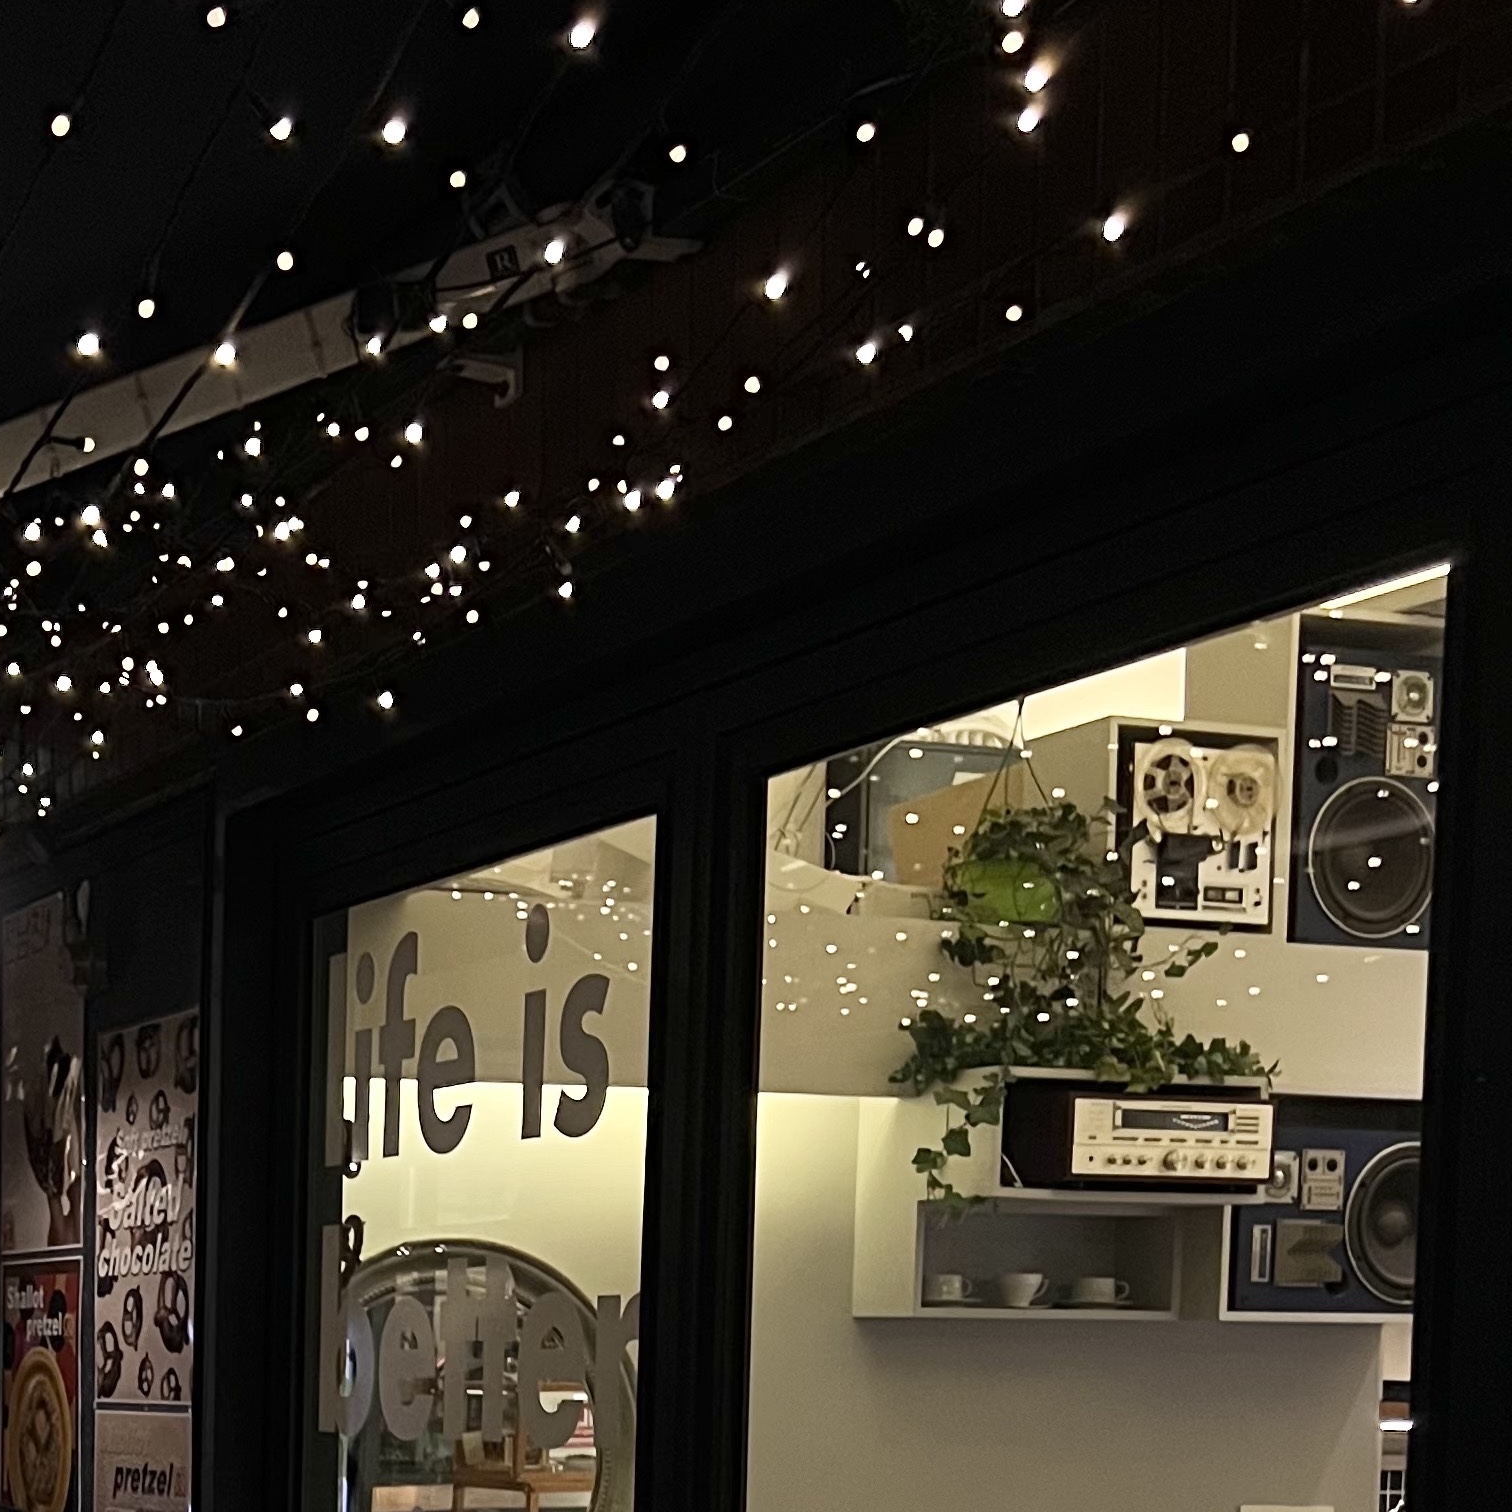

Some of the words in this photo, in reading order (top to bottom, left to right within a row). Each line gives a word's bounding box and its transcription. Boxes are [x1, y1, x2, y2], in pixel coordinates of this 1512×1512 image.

[324, 931, 476, 1167] life
[521, 903, 610, 1138] is
[108, 1173, 184, 1231] Salted
[97, 1233, 192, 1278] chocolate
[6, 1284, 45, 1309] Shallot
[25, 1311, 63, 1342] pretzel
[317, 1223, 643, 1449] better
[112, 1462, 174, 1499] pretzel
